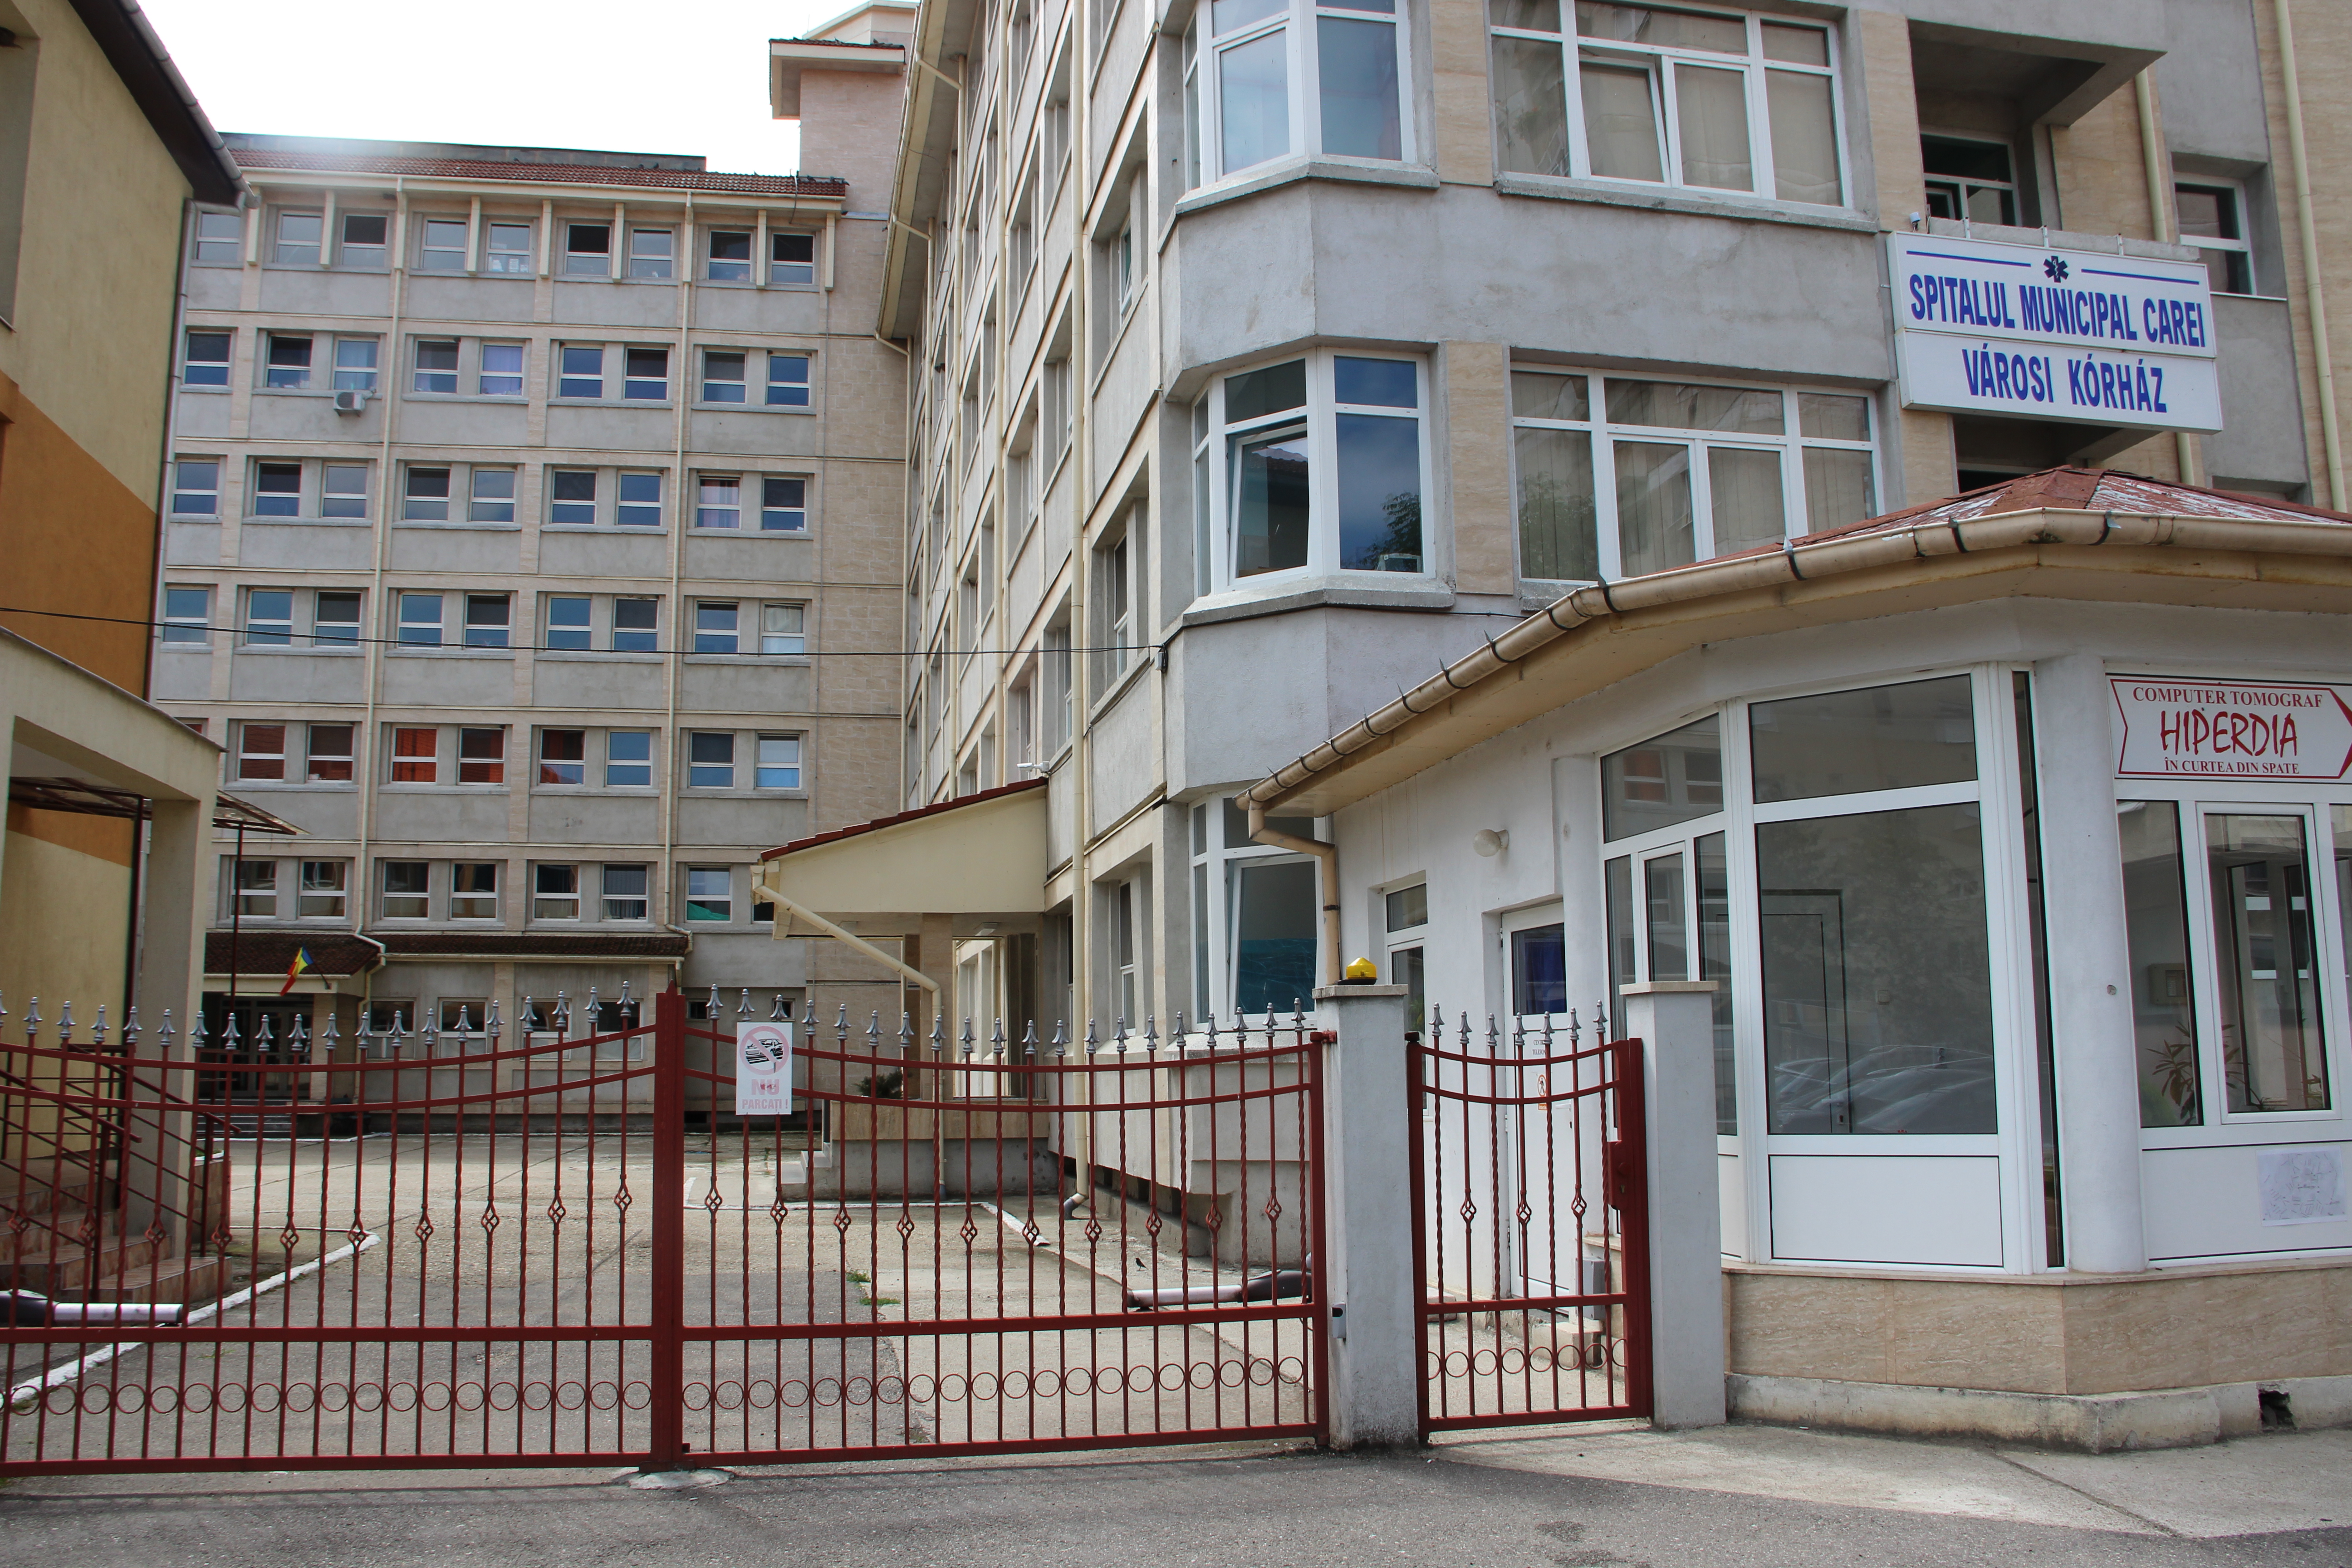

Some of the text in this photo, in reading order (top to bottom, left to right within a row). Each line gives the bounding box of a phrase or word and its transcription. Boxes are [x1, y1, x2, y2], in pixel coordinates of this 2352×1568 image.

[1909, 274, 2206, 348] SPITALUL MUNICIPAL CAREI
[1962, 343, 2168, 413] VÁROSI KÓRHÁZ
[2133, 687, 2323, 708] COMPUTER TOMOGRAF
[2160, 708, 2298, 758] HIPERDIA
[2165, 757, 2300, 774] ÎN CURTEA DIN SPATE
[751, 1079, 779, 1095] NU
